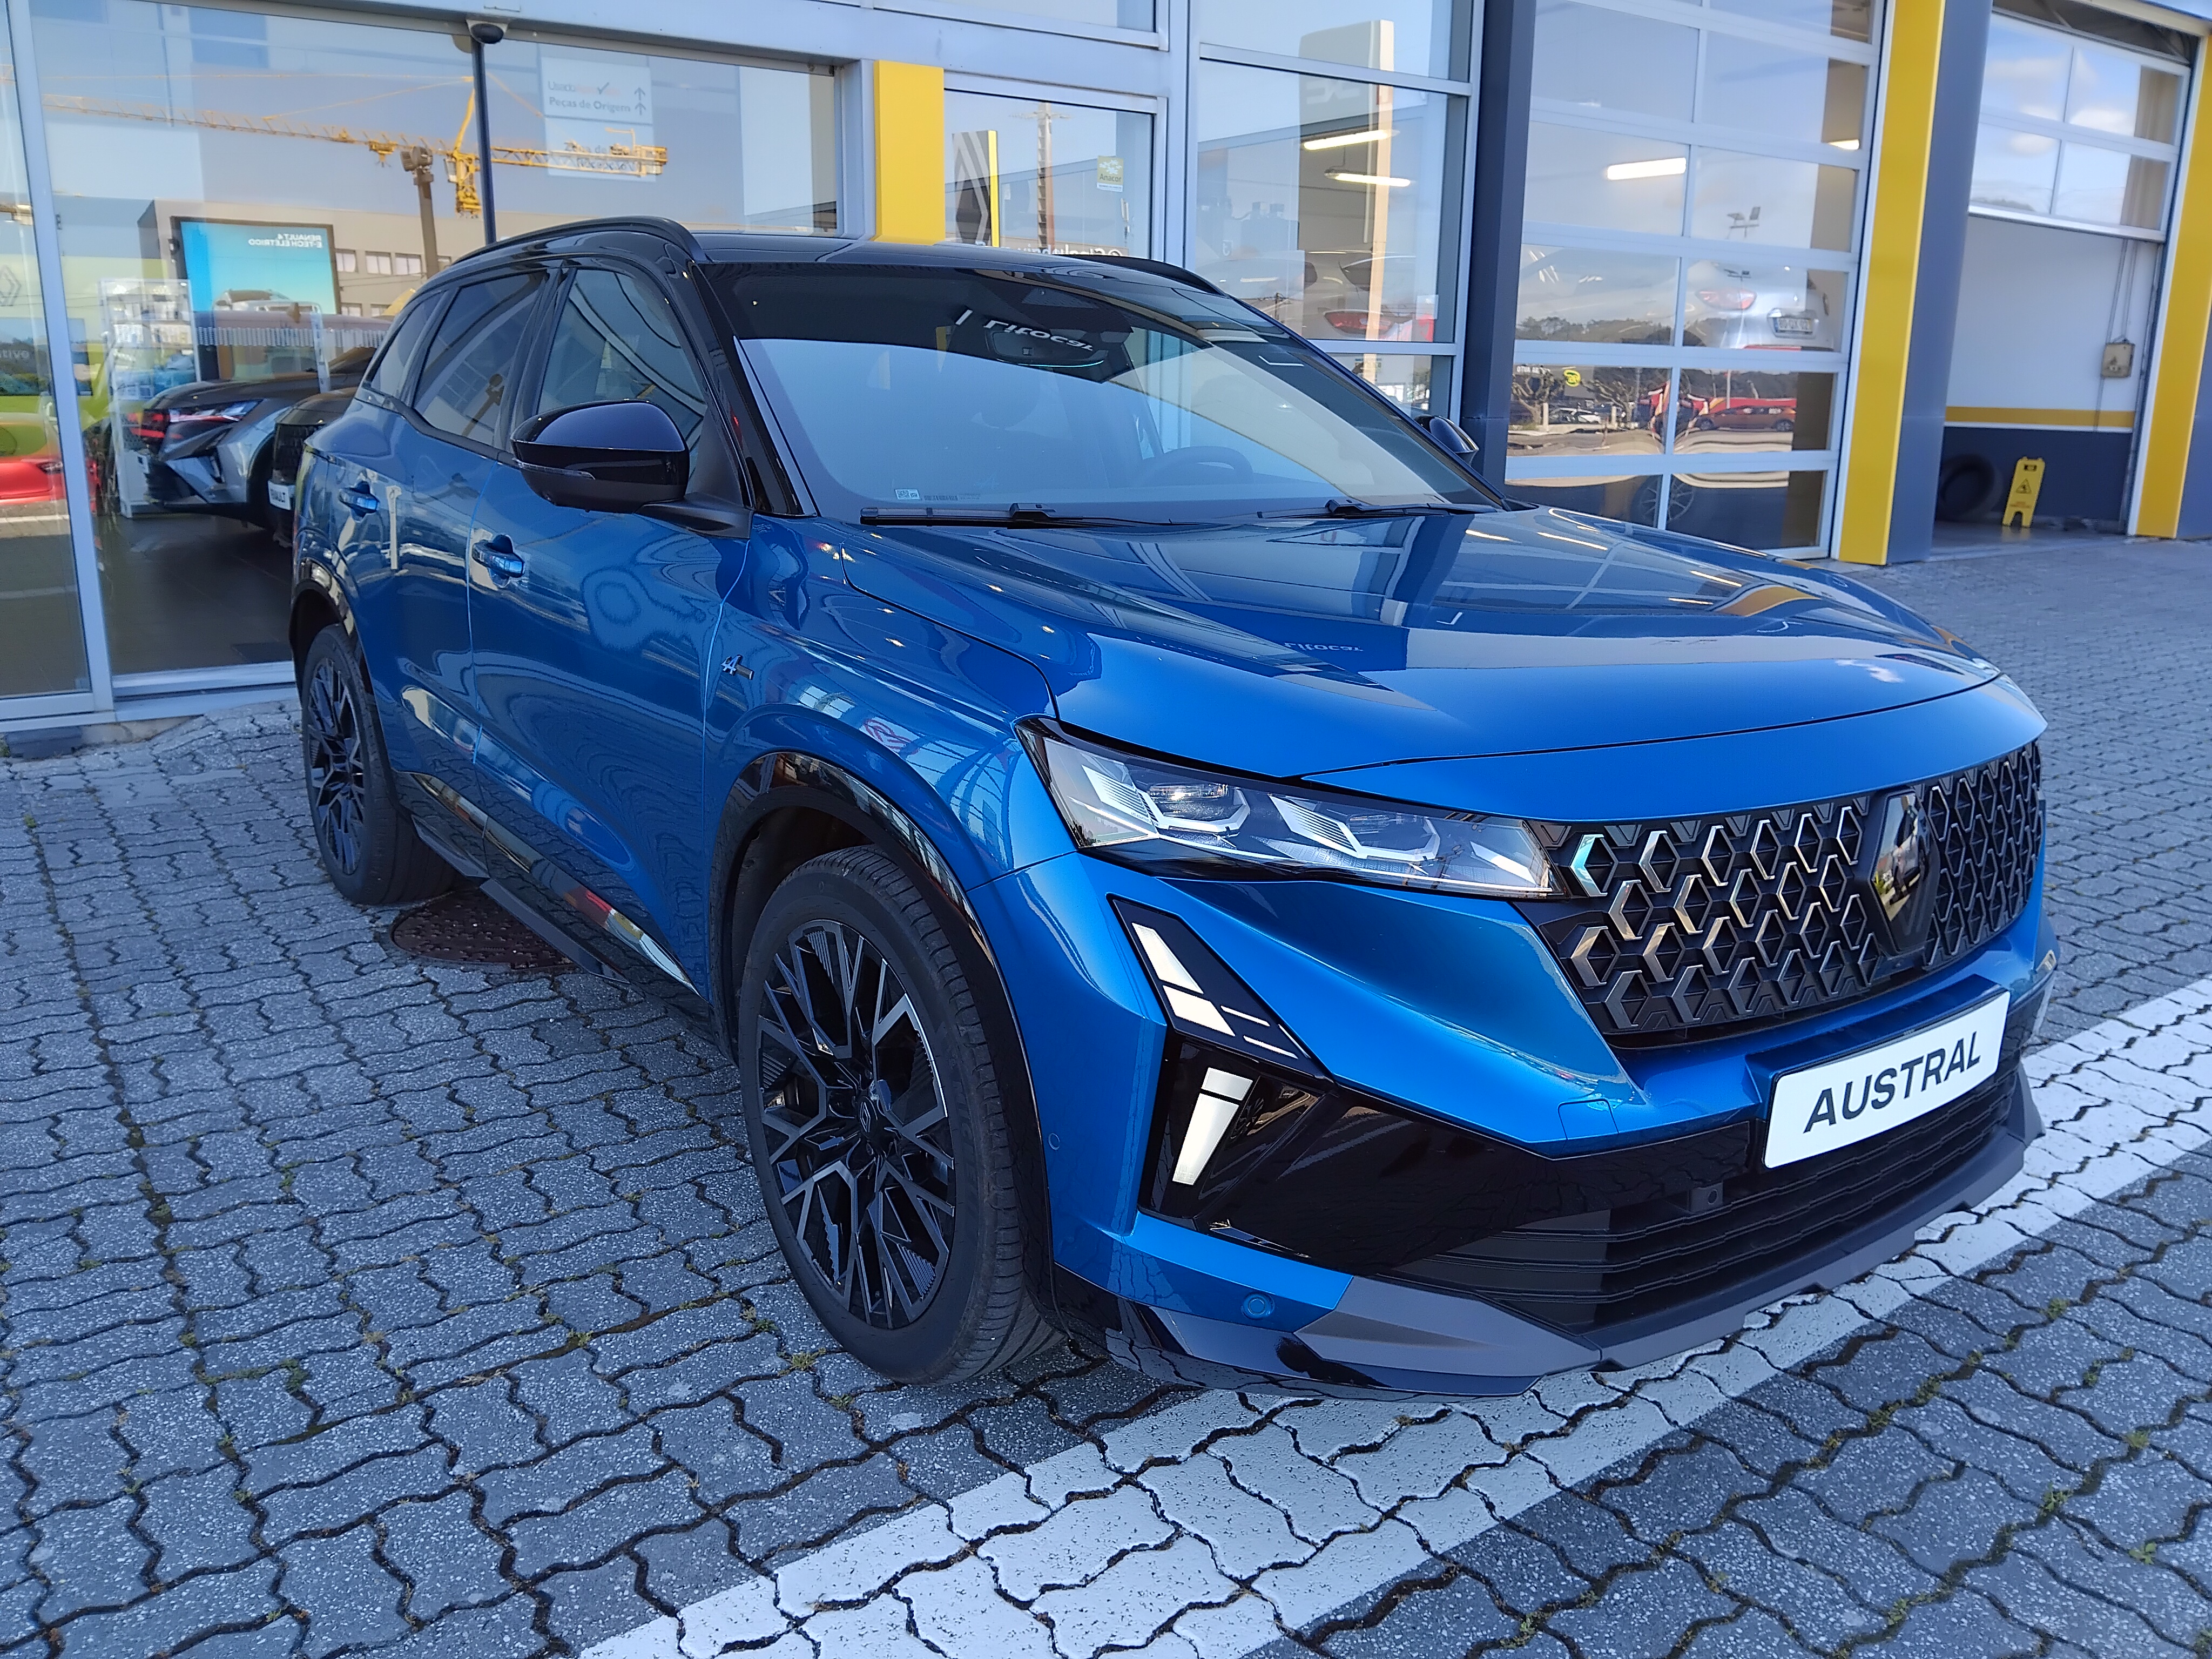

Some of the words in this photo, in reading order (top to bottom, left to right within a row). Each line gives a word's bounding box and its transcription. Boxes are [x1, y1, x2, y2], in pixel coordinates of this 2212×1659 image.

[549, 97, 577, 107] Peças
[579, 99, 591, 109] de
[594, 100, 631, 113] Origem
[1099, 173, 1122, 182] Anacor
[1803, 1031, 1981, 1134] AUSTRAL
